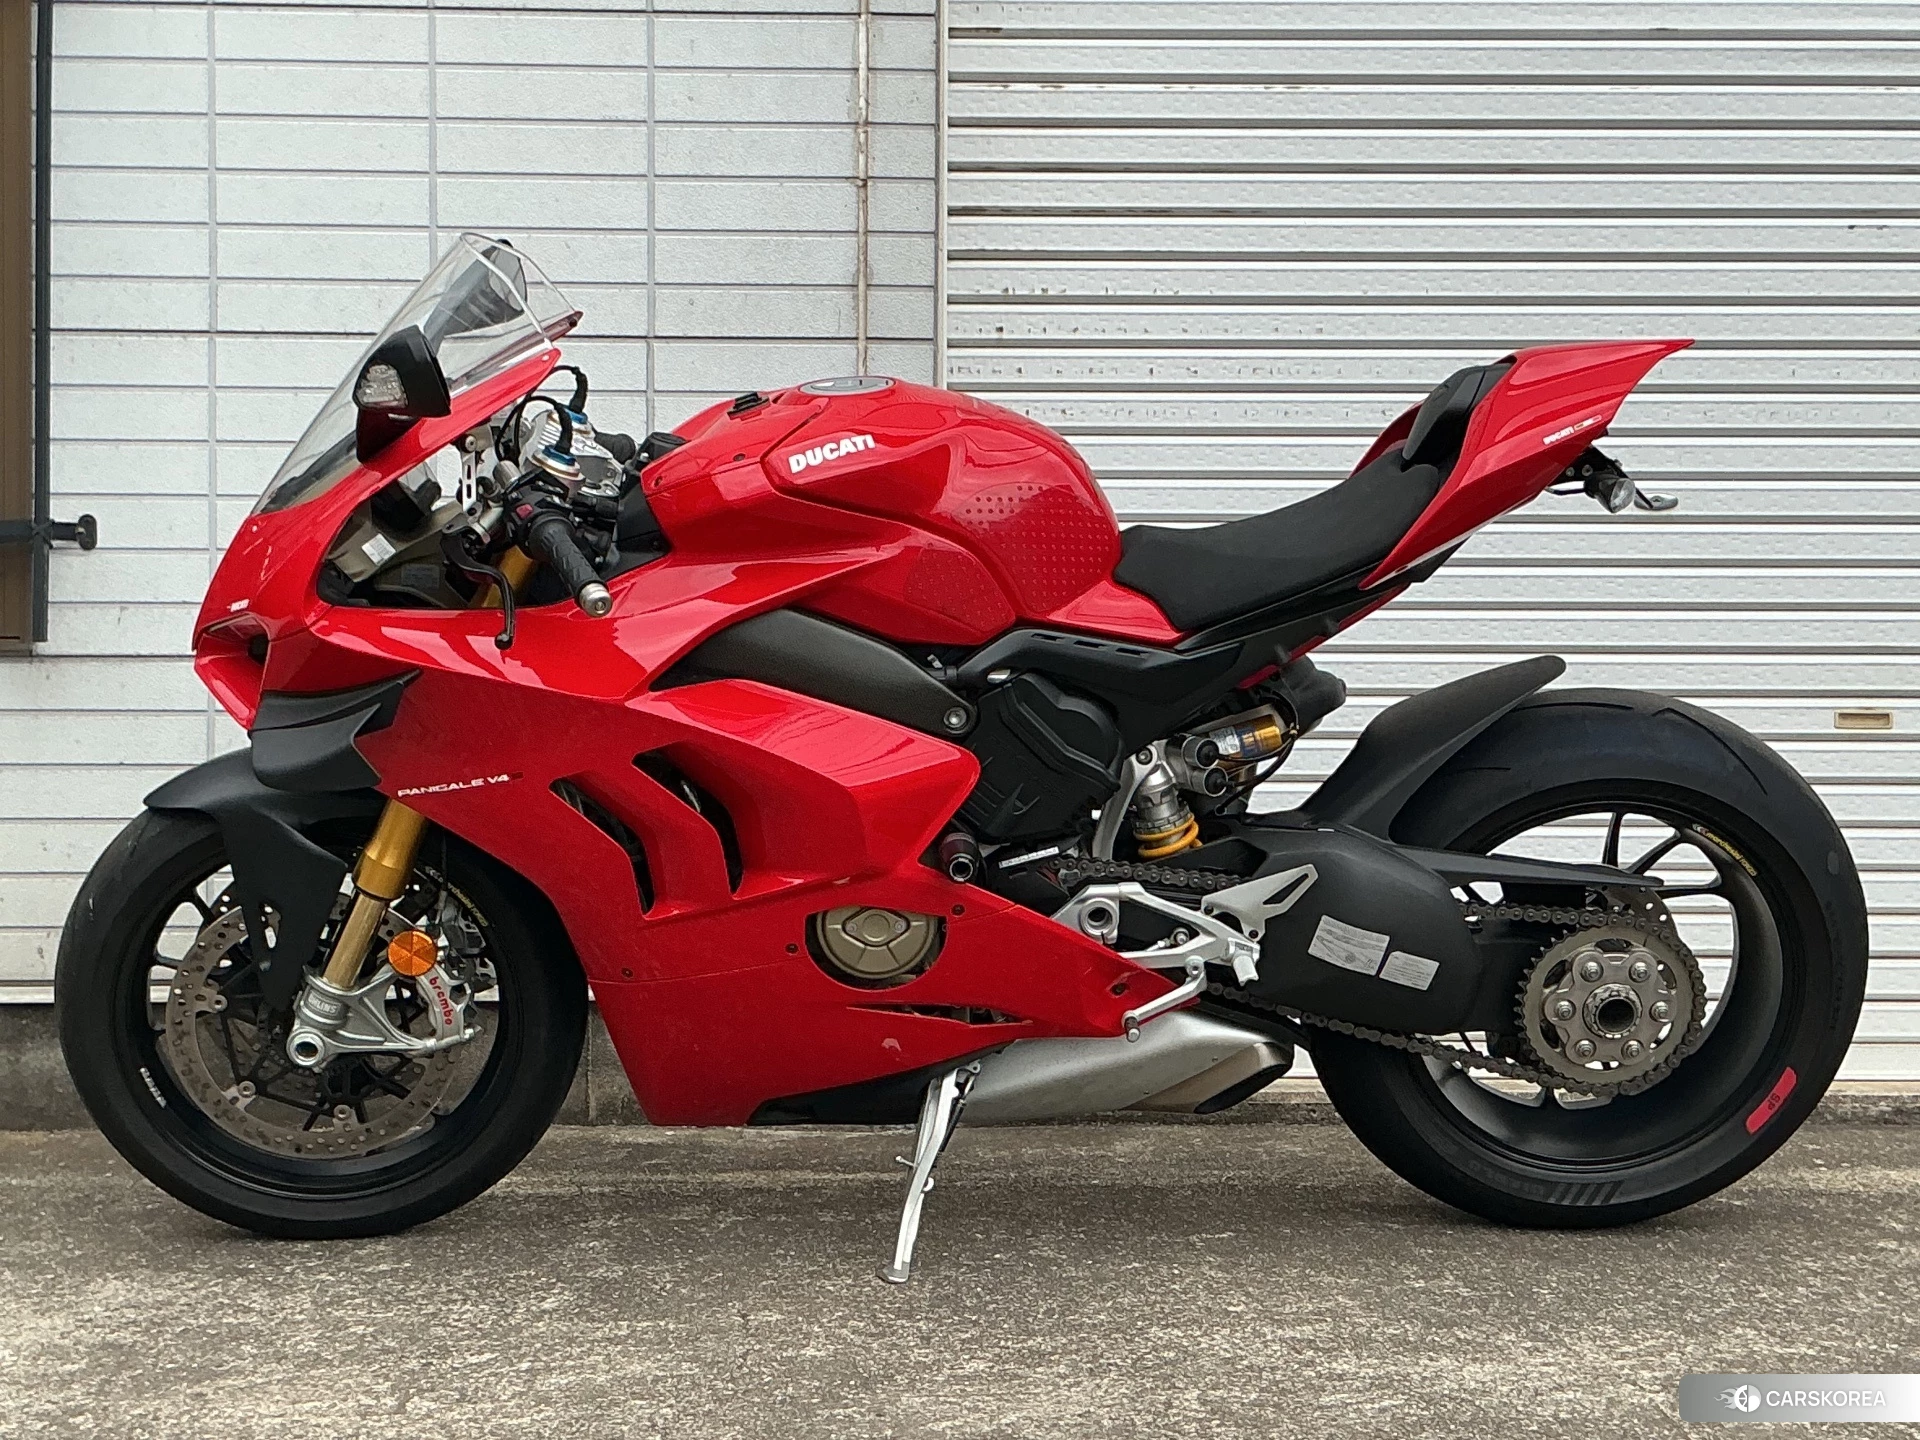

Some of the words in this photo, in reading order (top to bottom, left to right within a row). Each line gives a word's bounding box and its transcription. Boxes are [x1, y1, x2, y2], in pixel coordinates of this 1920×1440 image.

[788, 433, 876, 474] DUCATI
[397, 777, 485, 797] PANIGALE
[487, 773, 510, 784] V4
[428, 976, 454, 1026] brembo
